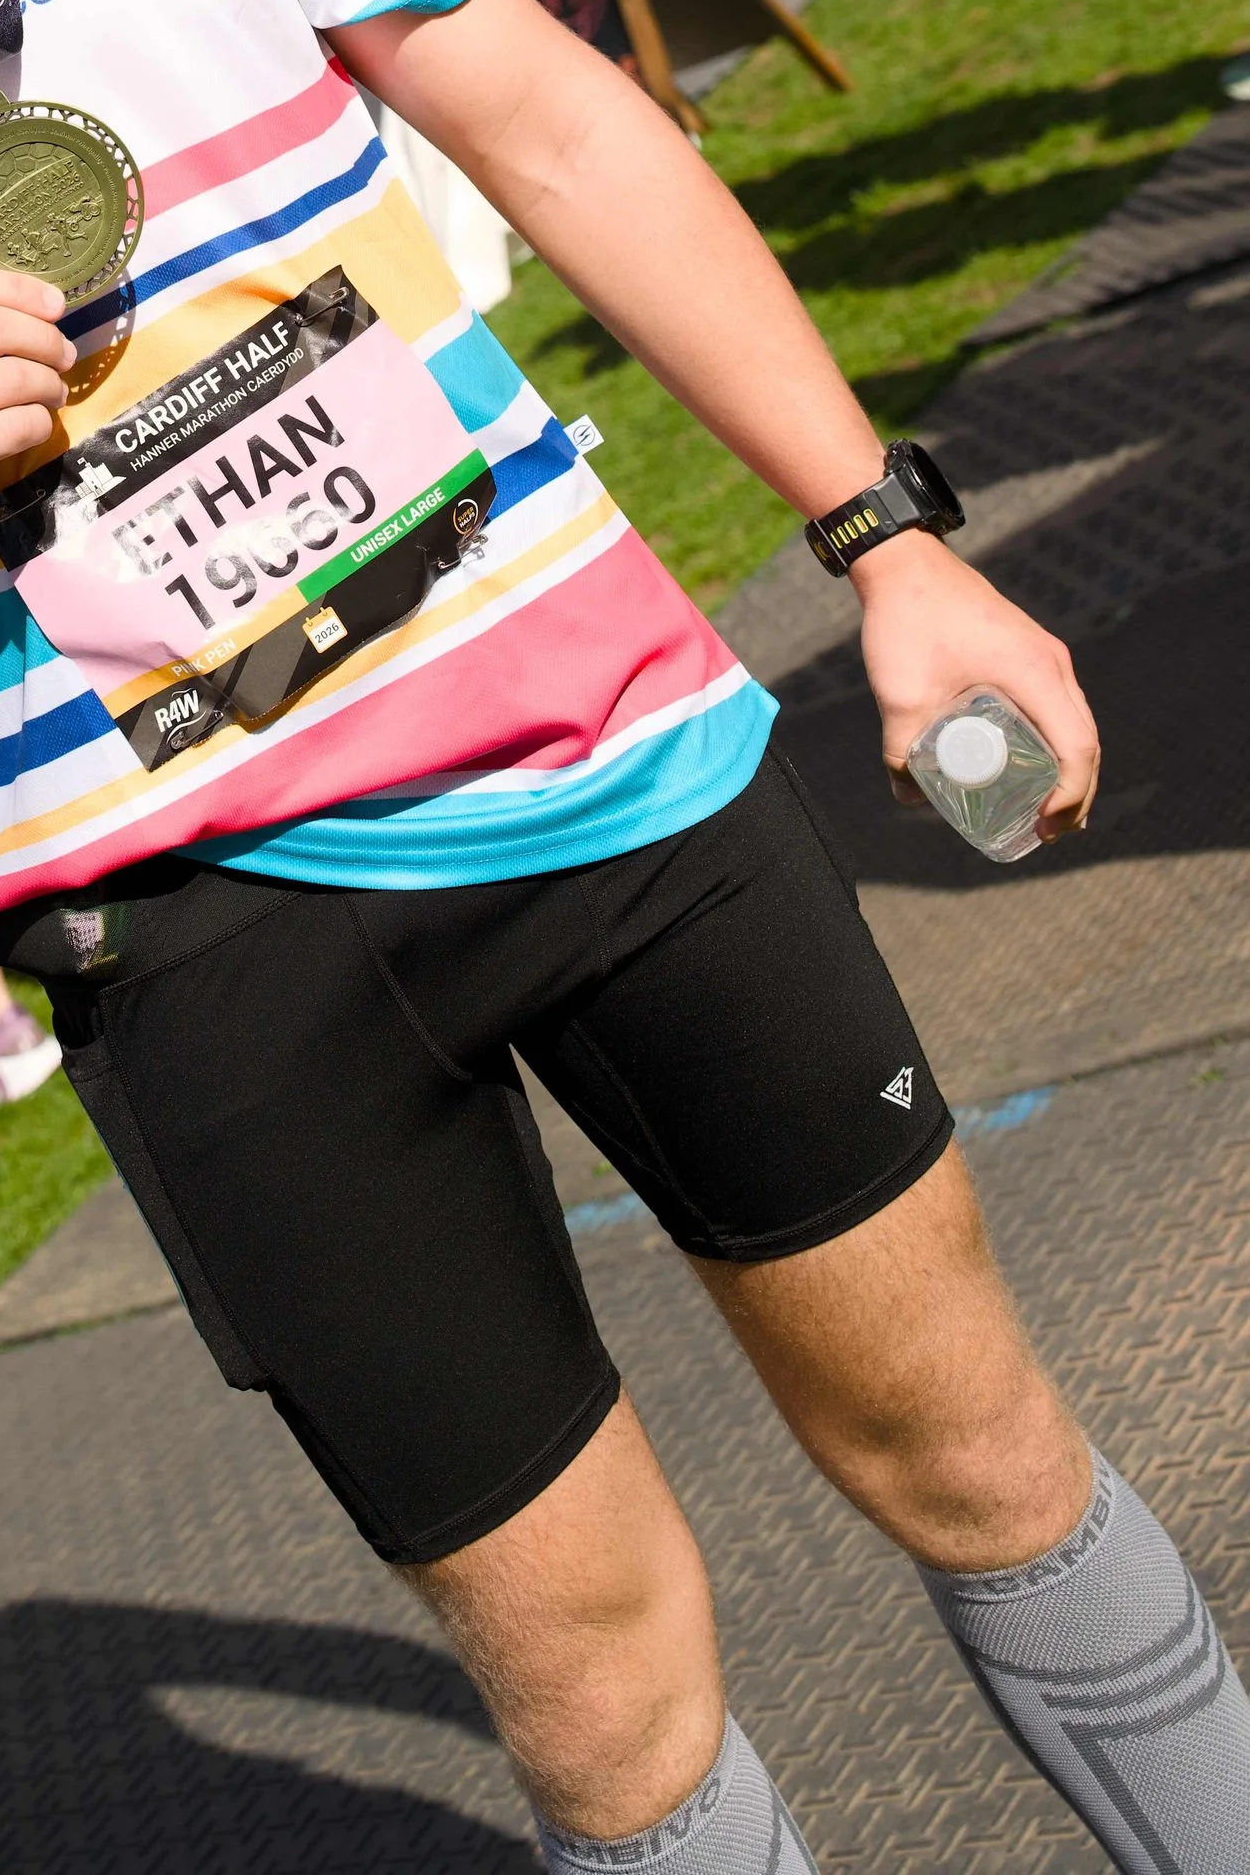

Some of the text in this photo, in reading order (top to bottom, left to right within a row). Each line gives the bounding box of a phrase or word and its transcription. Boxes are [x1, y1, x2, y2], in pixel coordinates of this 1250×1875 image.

[114, 320, 290, 453] CARDIFF HALF
[129, 346, 305, 473] HANNER MARATHON CAERDYDD
[111, 394, 346, 576] ETHAN
[350, 486, 447, 564] UNISEX LARGE
[171, 637, 238, 678] PINK PEN
[314, 622, 341, 644] 2026
[154, 689, 201, 733] R4W
